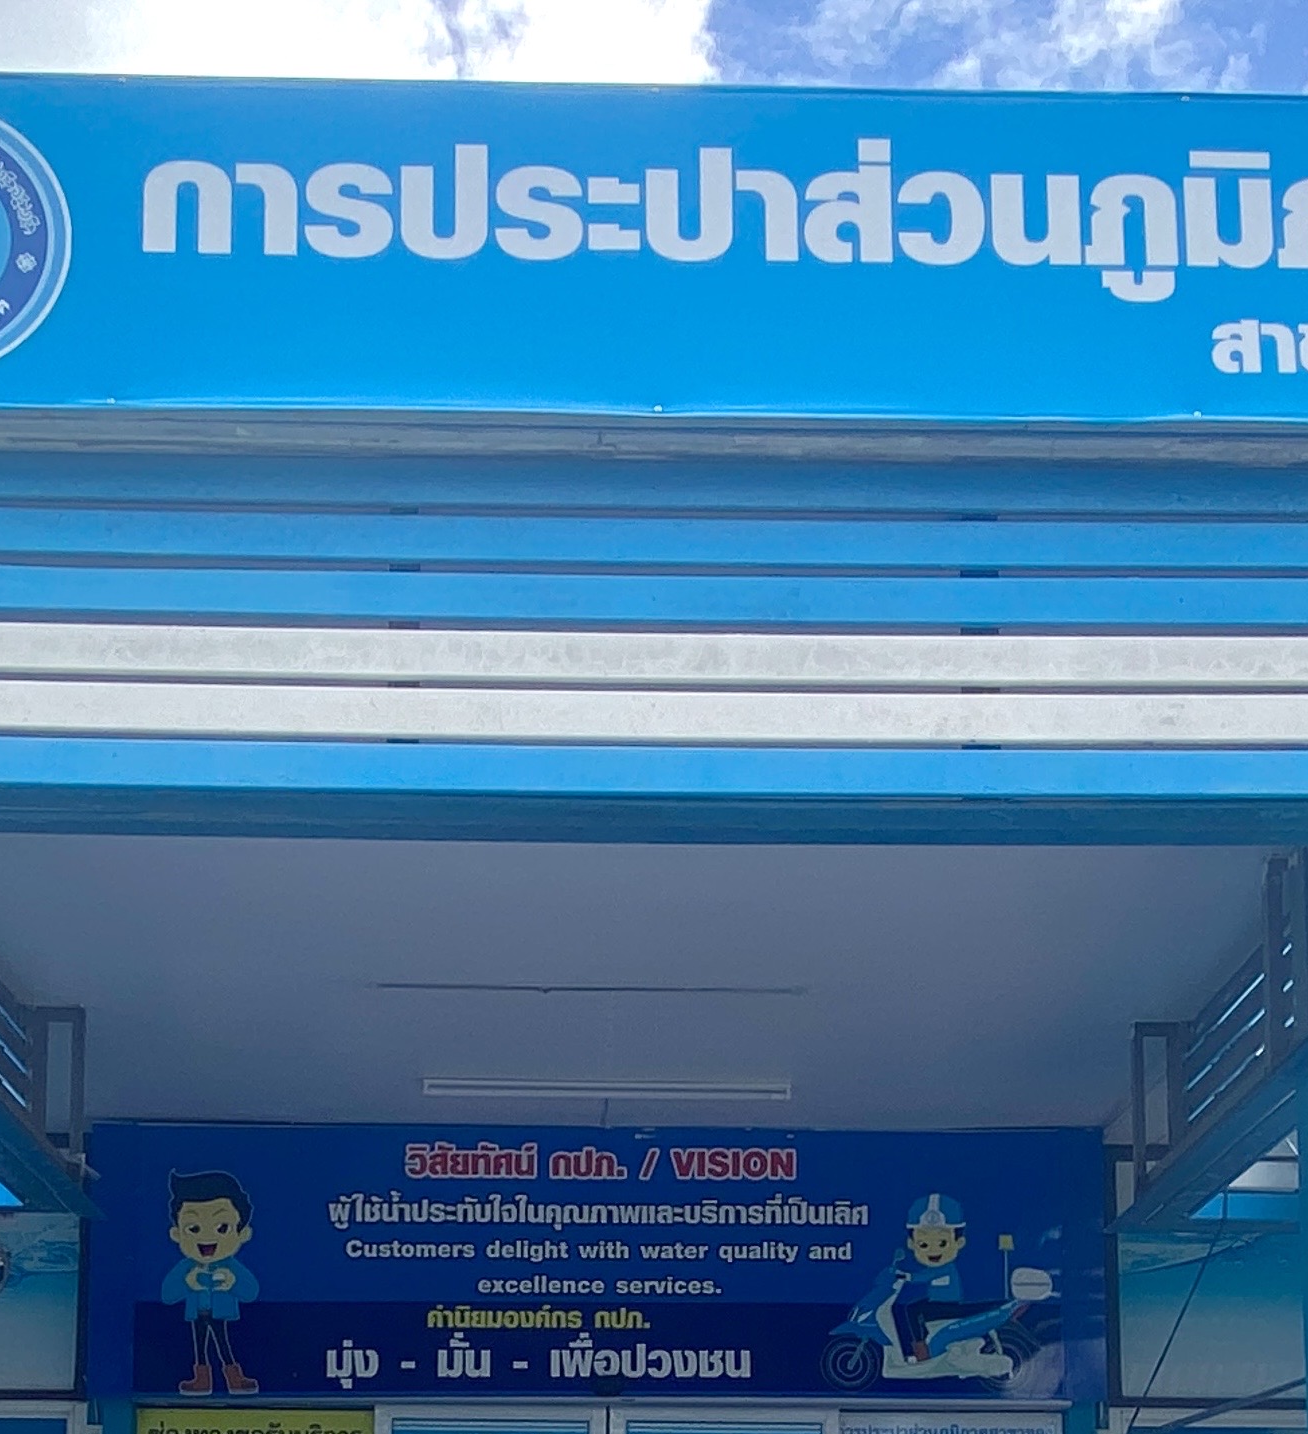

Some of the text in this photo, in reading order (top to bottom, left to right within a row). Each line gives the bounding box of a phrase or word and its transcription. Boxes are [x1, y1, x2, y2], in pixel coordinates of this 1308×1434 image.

[404, 1142, 538, 1180] วิสัยทัศน์
[670, 1148, 798, 1181] VISION
[345, 1240, 852, 1263] Customers delight with water quality and
[477, 1277, 723, 1295] excellence services.
[427, 1305, 582, 1330] ค่านิยมองค์กร
[325, 1339, 380, 1388] มุ่ง
[436, 1332, 492, 1379] มั่น
[549, 1331, 752, 1379] เพื่อปวงชน
